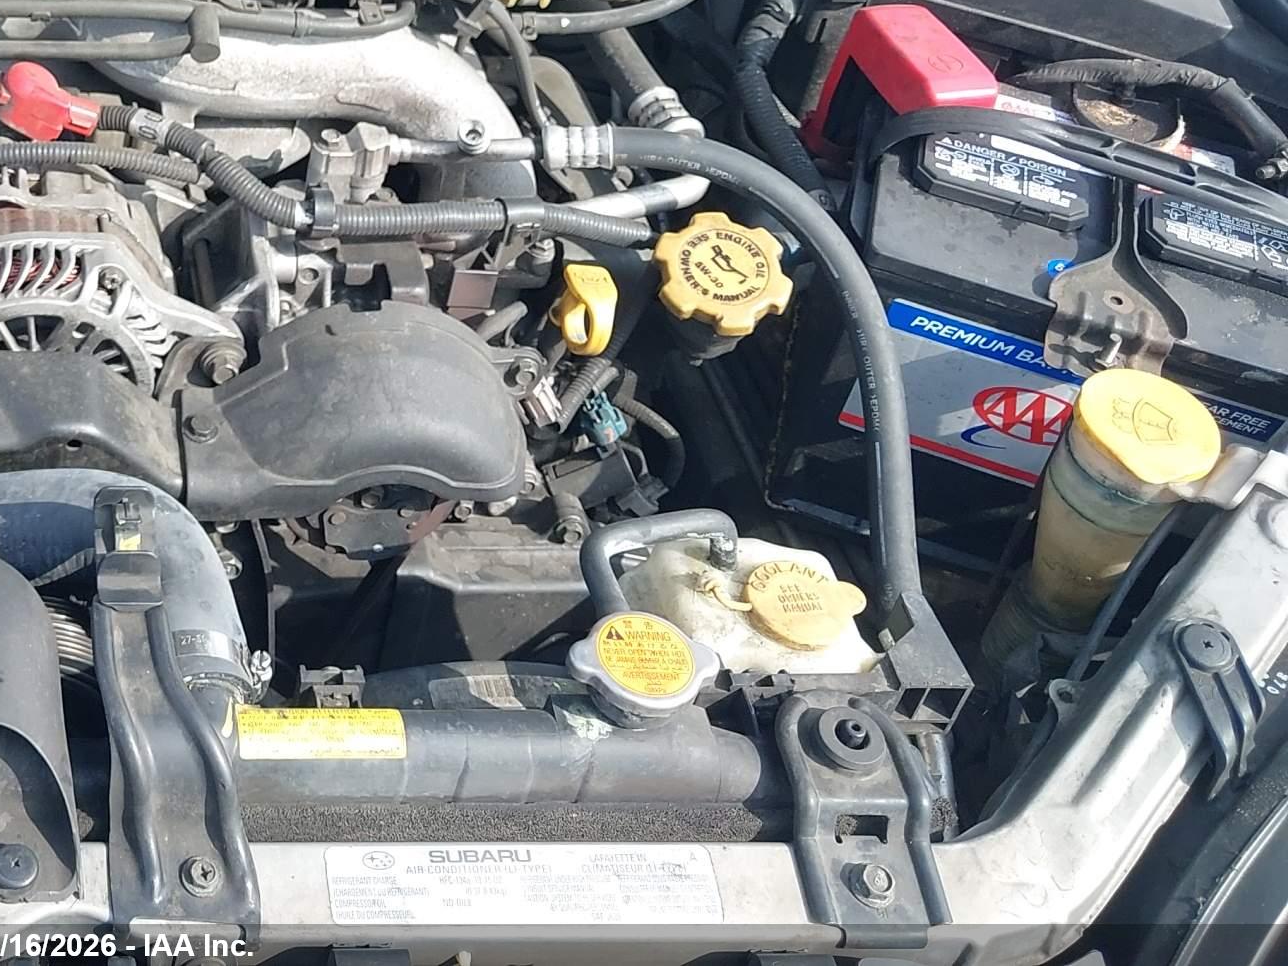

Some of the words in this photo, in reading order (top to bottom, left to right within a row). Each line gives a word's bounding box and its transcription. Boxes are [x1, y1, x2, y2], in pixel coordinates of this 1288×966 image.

[953, 140, 1007, 161] DANGER
[1018, 157, 1067, 177] POISON
[687, 233, 710, 249] SEE
[712, 285, 761, 302] MANUAL
[715, 232, 761, 258] ENGINE
[755, 261, 766, 279] OIL
[910, 315, 1016, 357] PREMIUM
[863, 355, 876, 390] OUTER
[1230, 408, 1271, 429] FREE
[750, 562, 829, 593] COOLANT
[782, 601, 823, 614] MANUAL
[624, 630, 671, 642] WARNING
[428, 849, 532, 863] SUBARU
